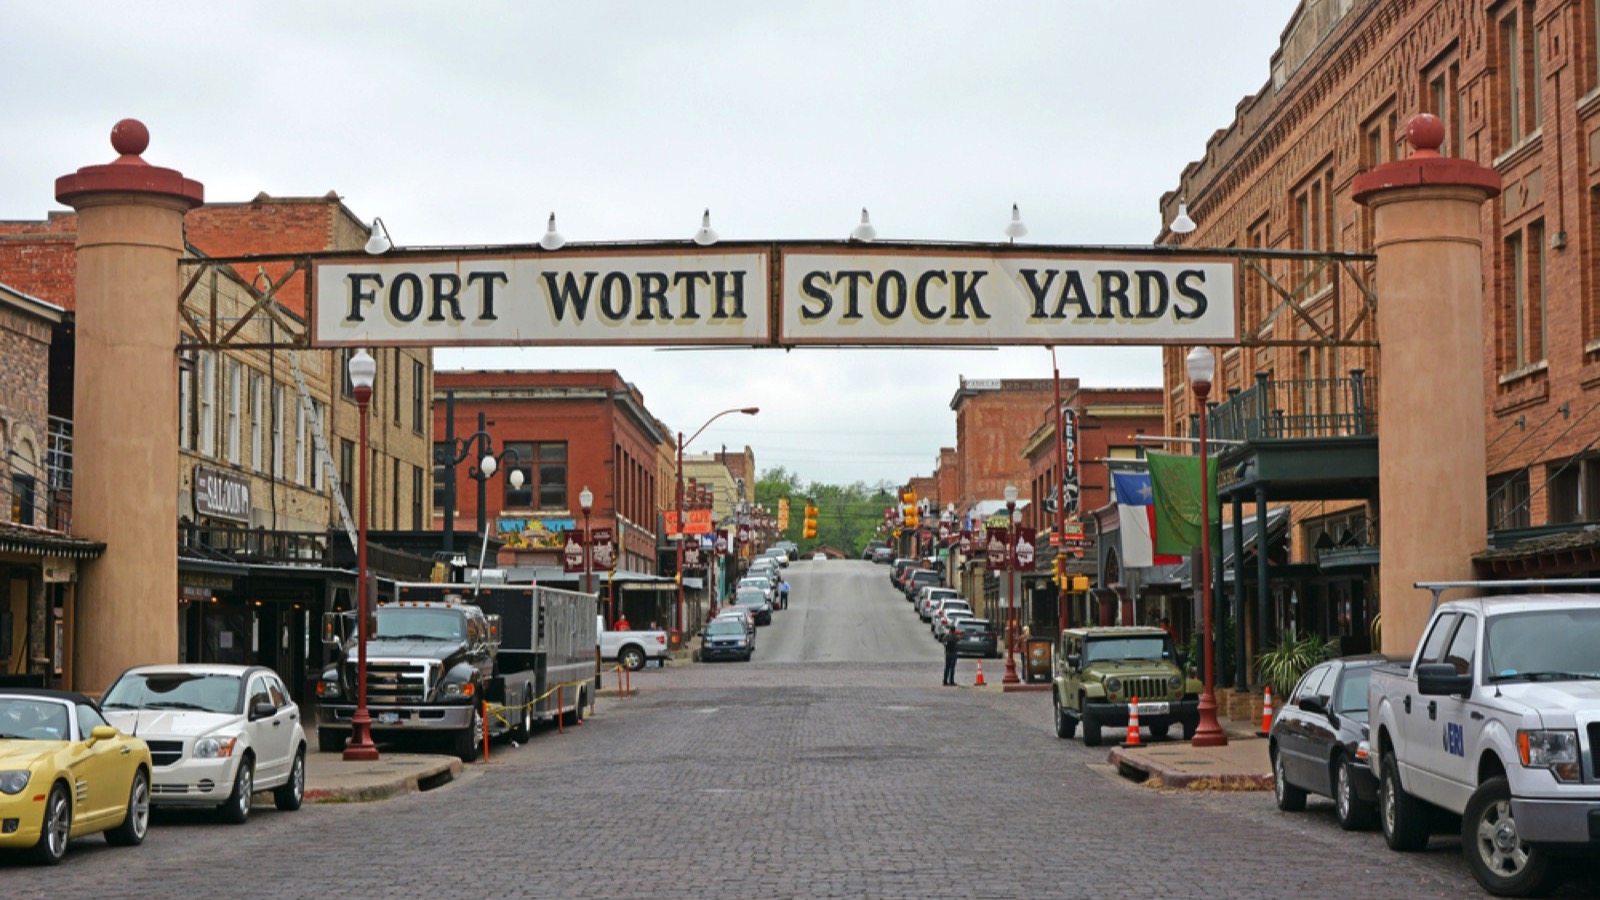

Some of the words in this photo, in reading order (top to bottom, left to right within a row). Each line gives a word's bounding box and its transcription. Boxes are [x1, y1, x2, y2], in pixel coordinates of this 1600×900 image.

[344, 272, 509, 322] FORT
[541, 270, 748, 321] WORTH
[800, 269, 991, 320] STOCK
[1018, 268, 1209, 321] YARDS
[207, 475, 241, 513] SALOON
